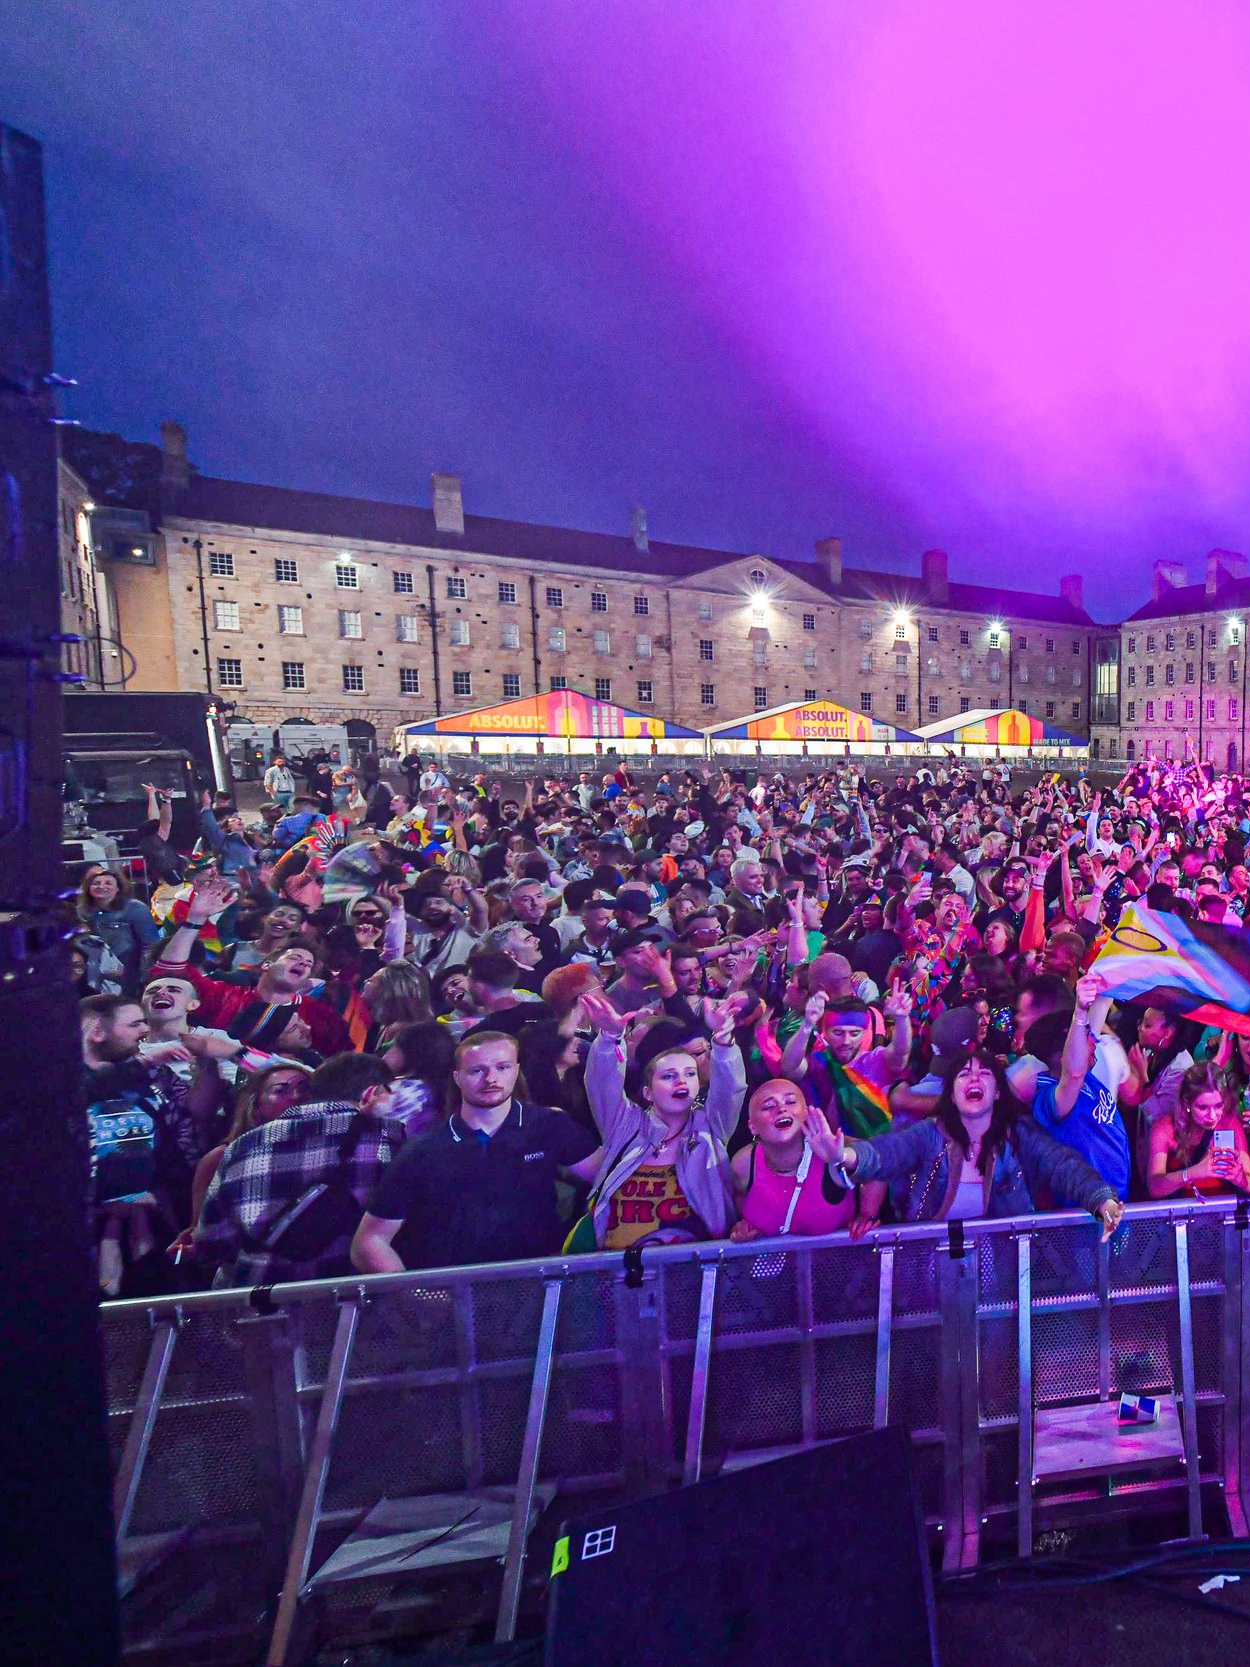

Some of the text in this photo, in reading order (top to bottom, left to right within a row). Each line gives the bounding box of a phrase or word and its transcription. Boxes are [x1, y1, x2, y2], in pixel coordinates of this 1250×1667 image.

[469, 714, 546, 729] ABSOLUT.
[795, 710, 847, 722] ABSOLUT.
[795, 726, 848, 738] ABSOLUT.
[523, 1151, 545, 1163] BOSS
